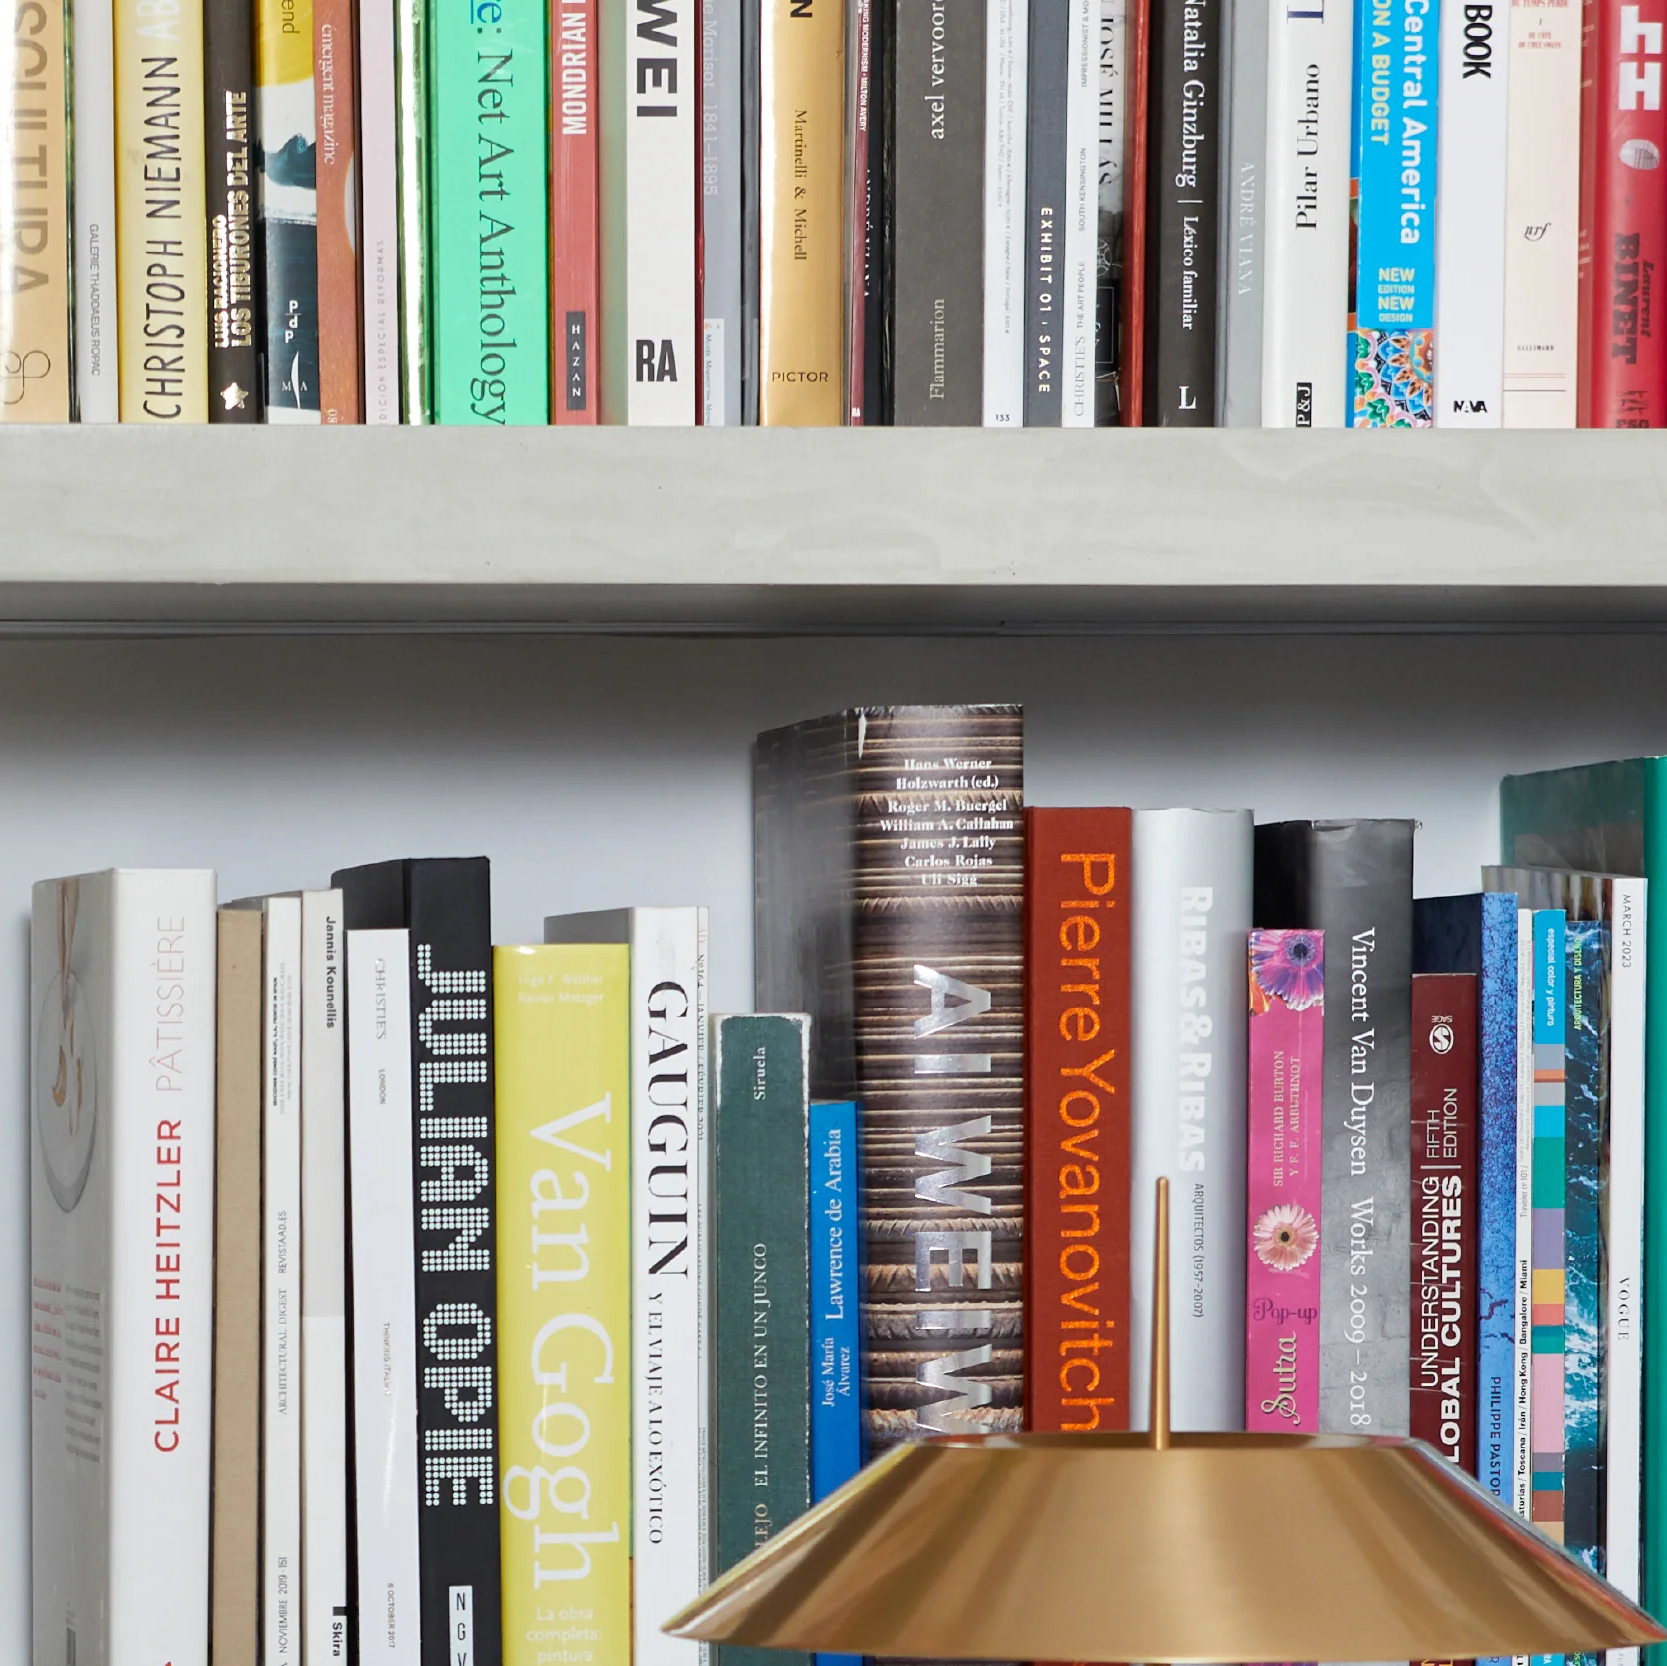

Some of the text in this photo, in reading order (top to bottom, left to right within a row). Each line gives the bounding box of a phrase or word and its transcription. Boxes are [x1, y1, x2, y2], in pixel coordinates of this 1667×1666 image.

[1371, 55, 1390, 145] BUDGET
[1462, 4, 1493, 79] BOOK
[141, 57, 184, 418] CHRISTOPH NIEMANN
[471, 49, 516, 425] Net Art Anthology
[794, 110, 808, 260] Martinelli & Michell
[1176, 80, 1204, 330] Ginzburg Léxico familiar
[1401, 117, 1428, 244] America
[636, 339, 677, 382] RA
[930, 299, 946, 399] Flammarion
[1038, 207, 1053, 392] EXHIBIT 01 SPACE
[773, 372, 829, 382] PICTOR
[880, 818, 1014, 831] William A. Callahan
[326, 916, 337, 1029] Jannis Kounellis
[1622, 895, 1631, 968] MARCH 2023
[149, 917, 185, 1452] CLAIRE HEITZLER PÂTISSIÈRE
[648, 982, 688, 1279] GAUGUIN
[1058, 854, 1117, 1431] Pierre Yovanovitch
[1343, 928, 1375, 1425] Vincent Van Duysen Works 2009 2018
[1427, 1109, 1438, 1158] FIFTH
[1444, 1089, 1457, 1158] EDITION
[416, 944, 494, 1506] JULIAN OPIE
[824, 1129, 844, 1320] Lawrence de Arabia
[1420, 1176, 1440, 1387] UNDERSTANDING
[1440, 1176, 1462, 1347] CULTURES
[503, 1092, 619, 1589] Van Gogh
[1618, 1277, 1629, 1340] VOGUE
[332, 1623, 342, 1657] Skira
